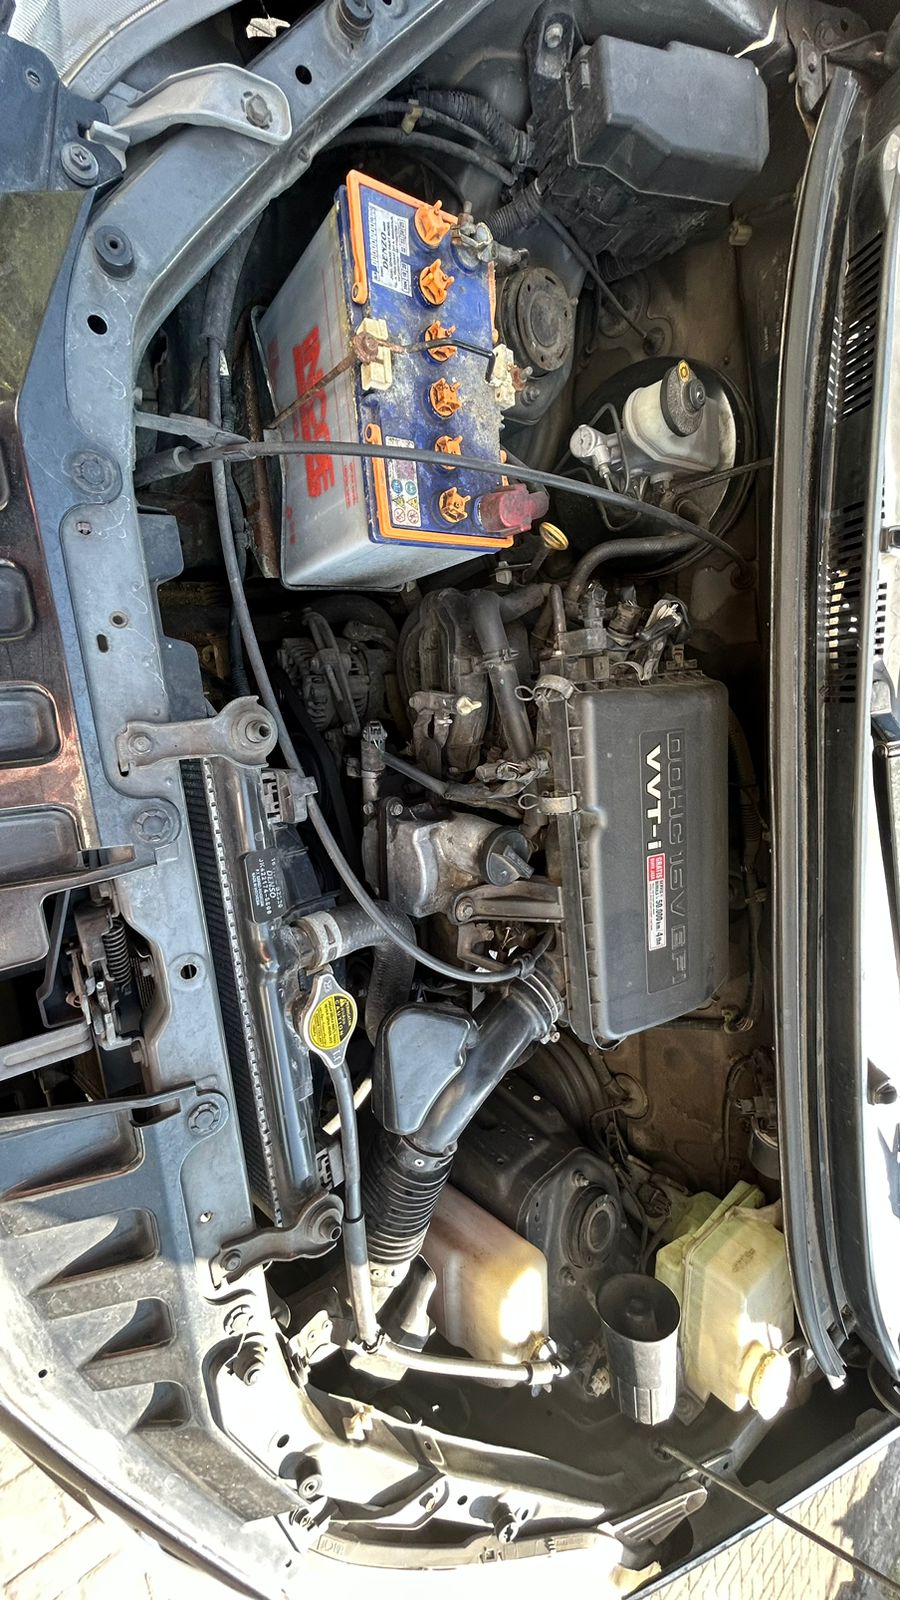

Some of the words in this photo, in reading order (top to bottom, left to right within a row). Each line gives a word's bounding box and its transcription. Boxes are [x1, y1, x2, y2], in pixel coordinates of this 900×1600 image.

[380, 231, 388, 270] DENZO
[645, 744, 662, 850] VVT-i
[666, 731, 685, 846] DOHC
[266, 870, 276, 898] DENSO
[655, 856, 664, 879] GRATIS
[669, 850, 686, 917] 16V
[655, 899, 664, 922] 50.000
[335, 999, 344, 1036] CAUTION
